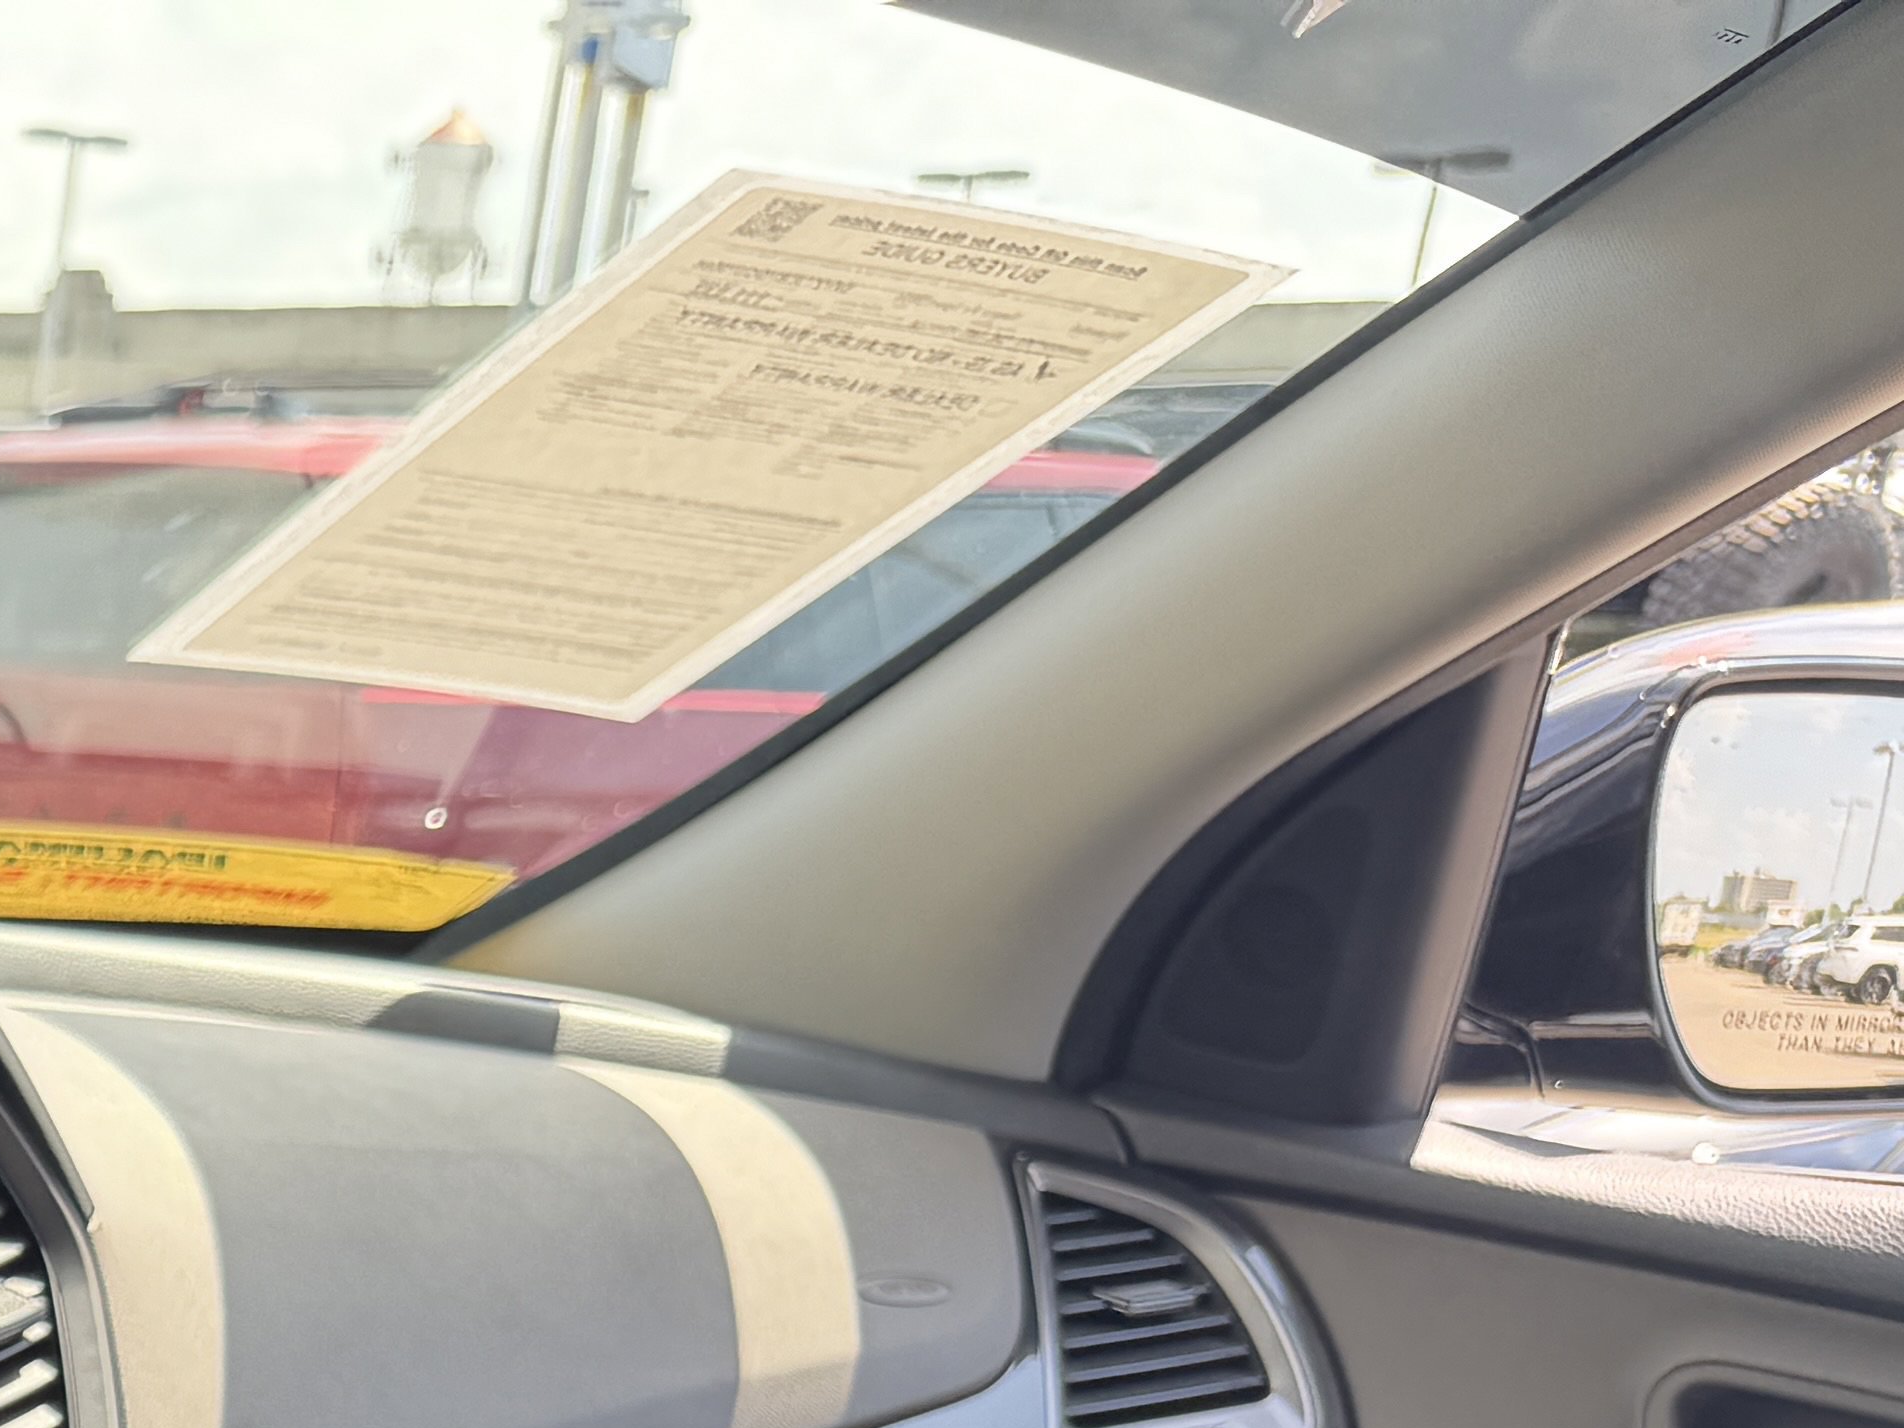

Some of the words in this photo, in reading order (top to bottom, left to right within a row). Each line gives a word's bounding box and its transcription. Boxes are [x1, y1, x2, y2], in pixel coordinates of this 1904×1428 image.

[1722, 1009, 1805, 1031] OBJECTS
[1811, 1013, 1828, 1031] IN
[1777, 1034, 1823, 1052] THAN
